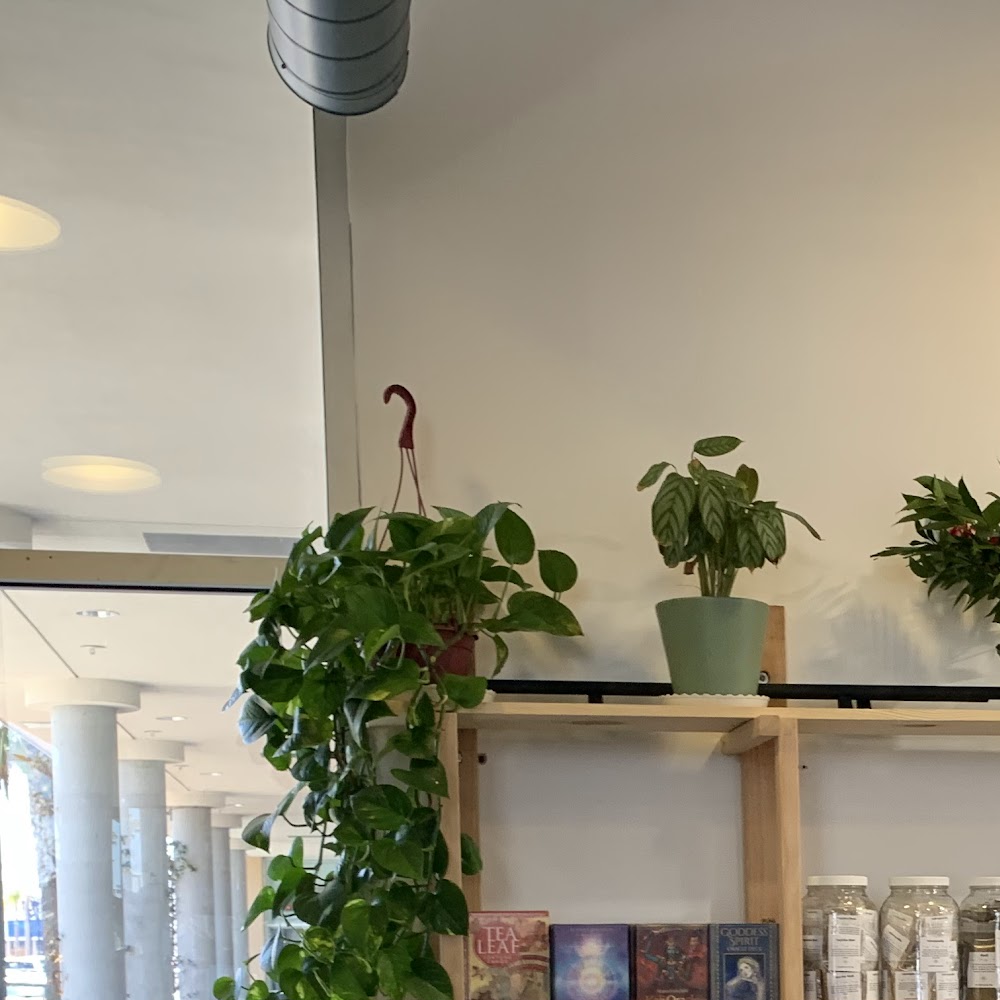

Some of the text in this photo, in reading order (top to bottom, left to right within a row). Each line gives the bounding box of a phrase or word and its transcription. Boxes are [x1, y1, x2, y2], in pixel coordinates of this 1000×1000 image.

[481, 926, 519, 941] TEA
[720, 927, 769, 937] GODDESS
[477, 939, 520, 954] LEAF
[729, 936, 760, 946] SPIRIT
